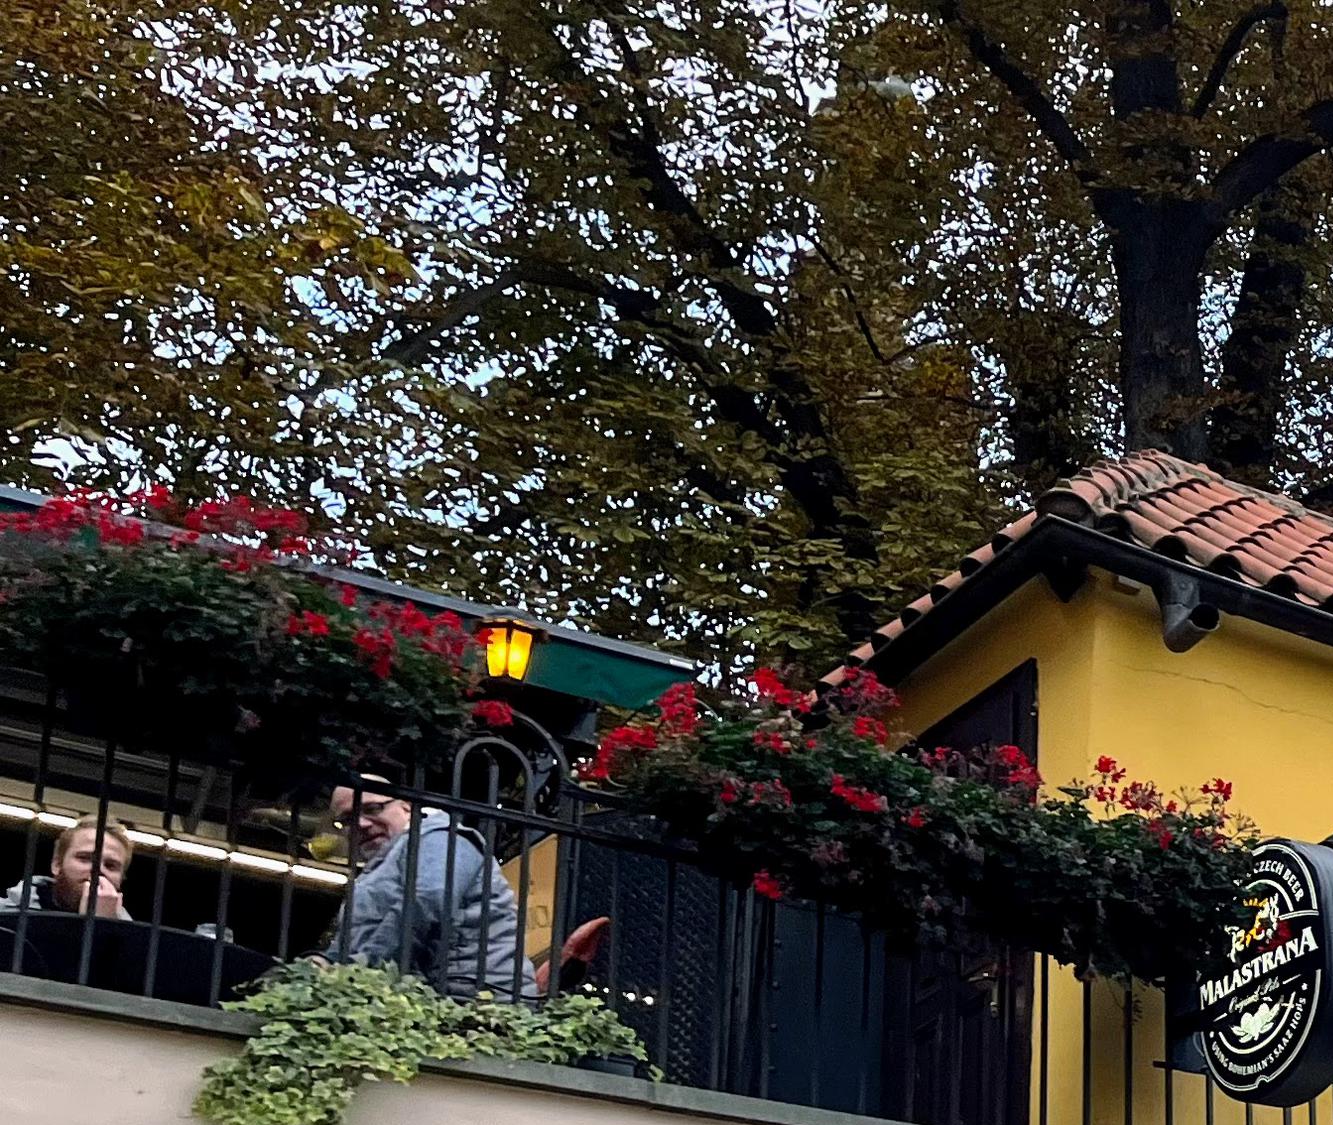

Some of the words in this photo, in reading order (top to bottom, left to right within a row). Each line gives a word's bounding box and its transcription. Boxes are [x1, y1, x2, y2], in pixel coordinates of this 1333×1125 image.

[1282, 868, 1305, 903] BEER
[1199, 926, 1319, 1010] MALASTRANA
[1273, 1029, 1294, 1058] SAAZ
